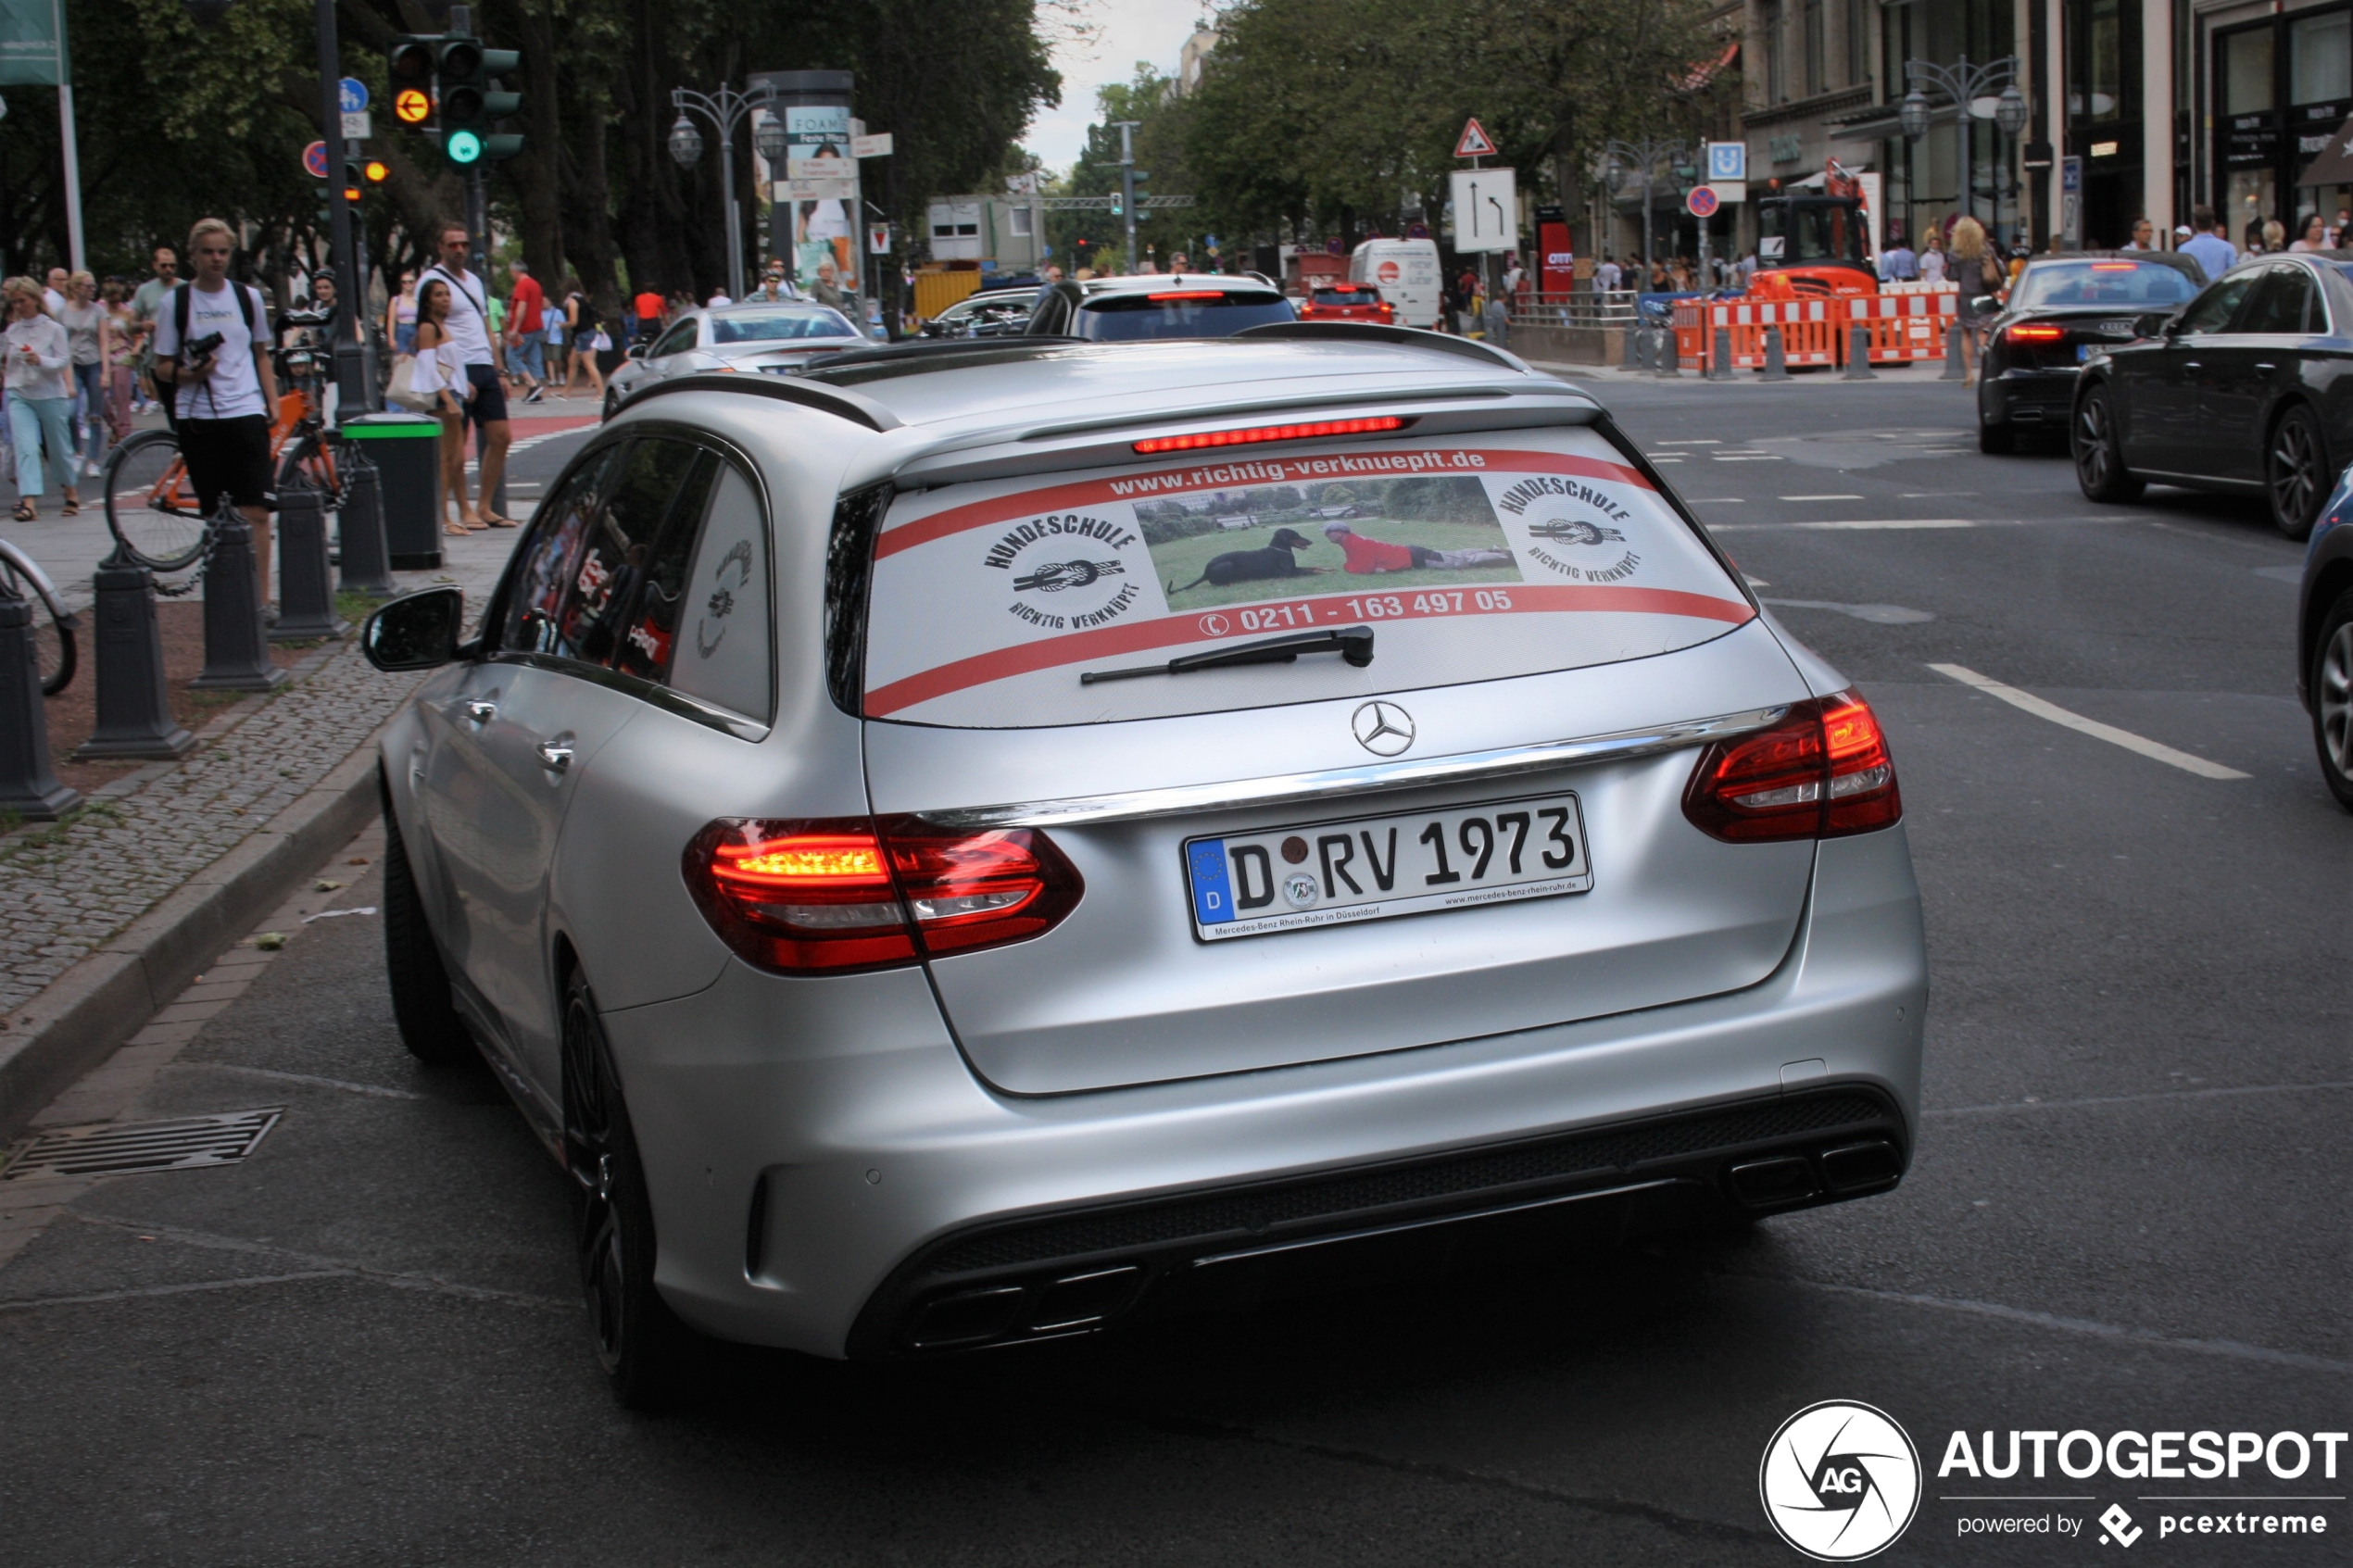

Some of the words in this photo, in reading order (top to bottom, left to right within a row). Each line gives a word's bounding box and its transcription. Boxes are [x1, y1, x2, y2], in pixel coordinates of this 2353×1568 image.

[1109, 452, 1487, 495] www.richtig-verknuepft.de
[1499, 477, 1630, 522] HUNDESCHULE
[984, 514, 1137, 570] HUNDESCHULE
[1528, 546, 1579, 580] RICHTIG
[1585, 550, 1642, 583] VERKNÜPFT
[1008, 601, 1064, 630] RICHTIG
[1071, 582, 1140, 630] VERKNÜPFT
[1239, 603, 1315, 631] 0211
[1346, 596, 1403, 620] 163
[1413, 591, 1464, 612] 497
[1477, 590, 1513, 610] 05
[1228, 845, 1275, 909] D
[1316, 827, 1397, 898] RV
[1417, 807, 1576, 885] 1973
[1445, 882, 1577, 905] www.mercedes-benz-rhein-ruhr.de
[1215, 922, 1277, 935] Mercedes-Benz
[1279, 915, 1324, 927] Rhein-Ruhr
[1326, 912, 1334, 921] in
[1336, 907, 1380, 920] Düsseldorf
